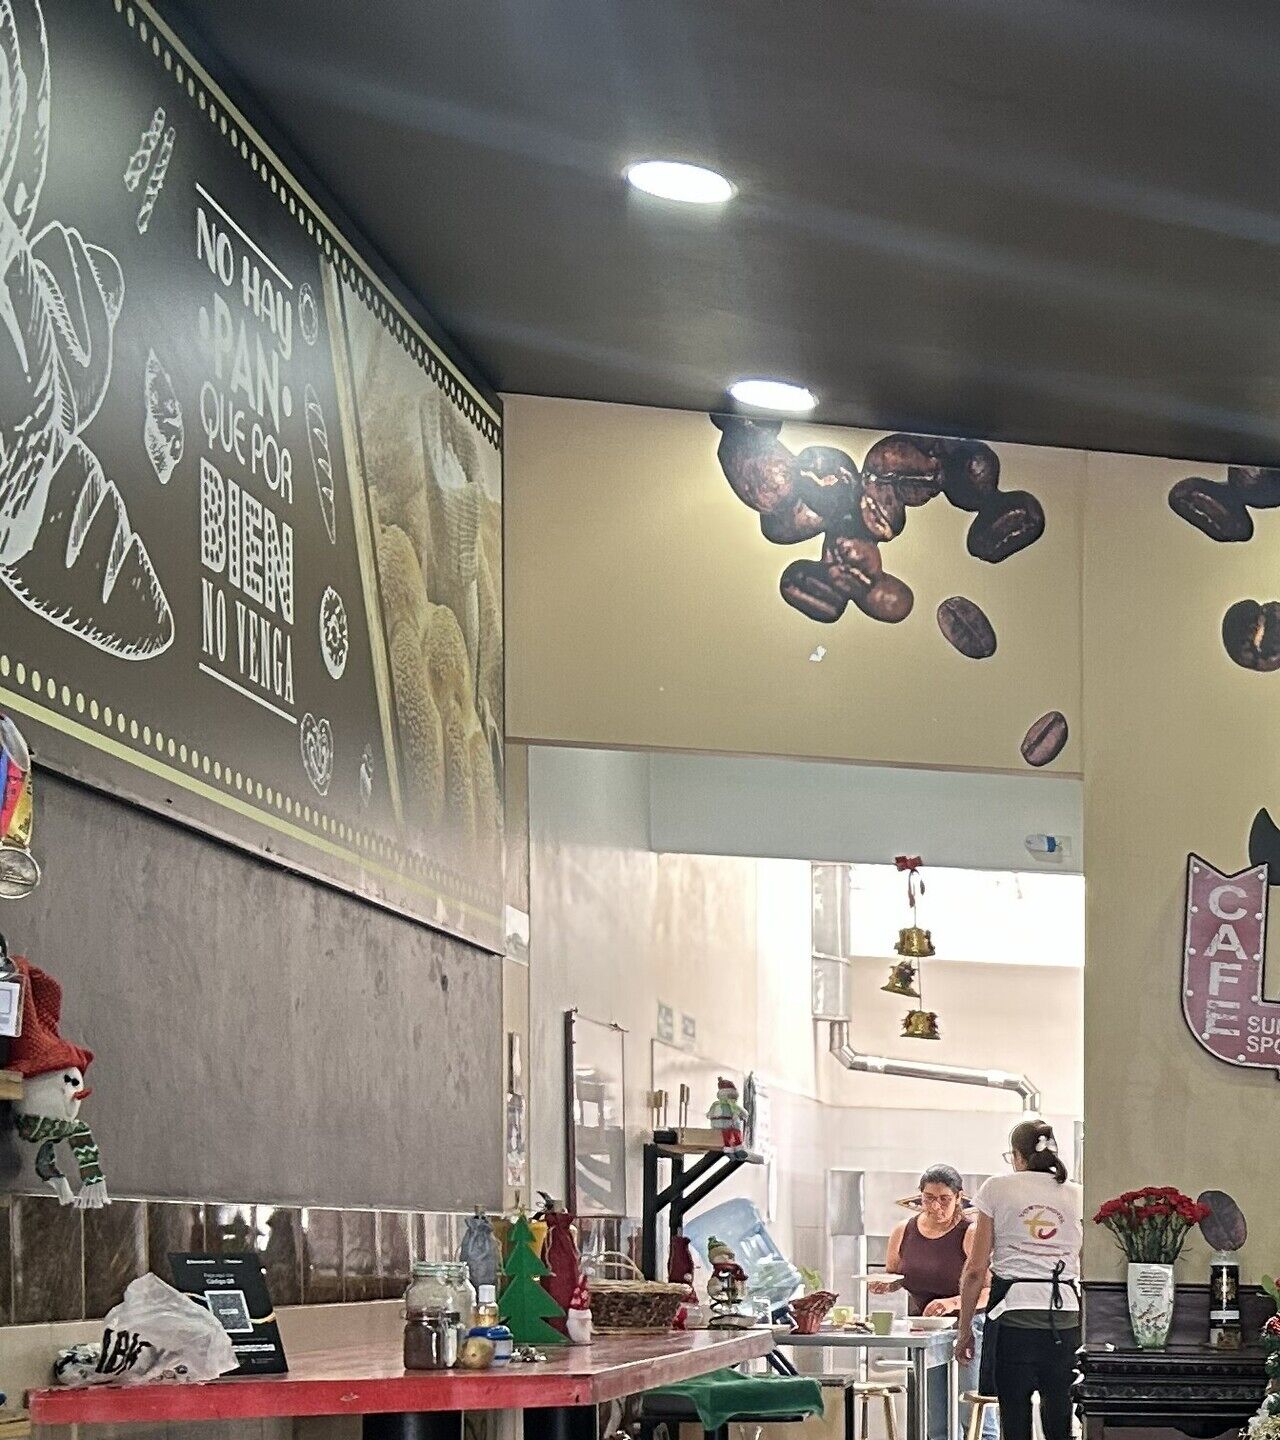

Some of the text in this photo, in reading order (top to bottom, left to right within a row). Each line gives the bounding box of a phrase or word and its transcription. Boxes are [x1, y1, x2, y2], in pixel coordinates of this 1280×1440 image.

[197, 207, 293, 361] NO HAY
[200, 380, 294, 505] QUE POR
[200, 456, 294, 626] BIEN
[202, 576, 295, 705] NO VENGA
[1203, 884, 1249, 1037] CAFE
